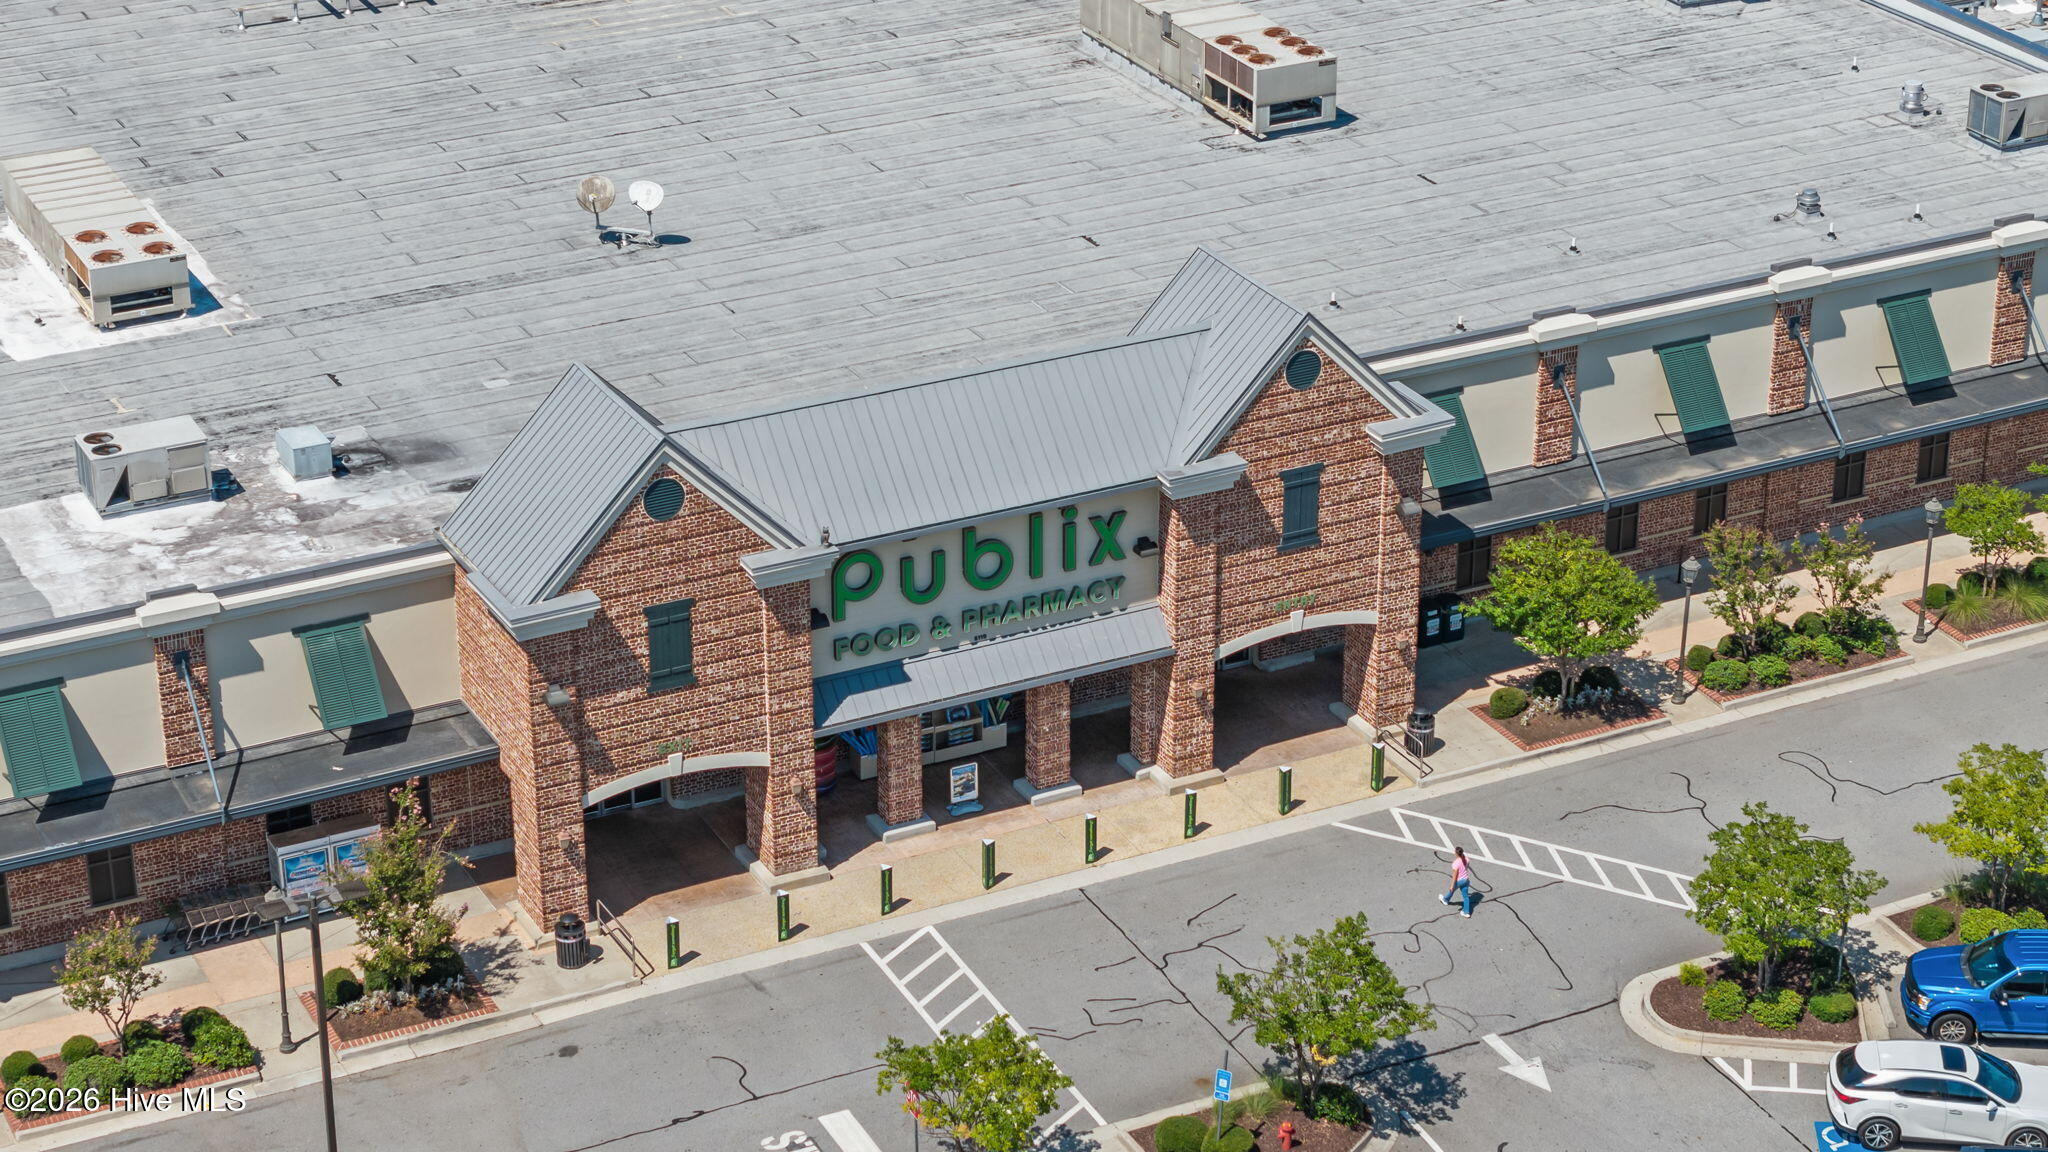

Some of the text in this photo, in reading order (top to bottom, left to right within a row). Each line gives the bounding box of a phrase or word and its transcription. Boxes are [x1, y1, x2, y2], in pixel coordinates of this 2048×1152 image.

[833, 575, 1127, 662] FOOD & PHARMACY
